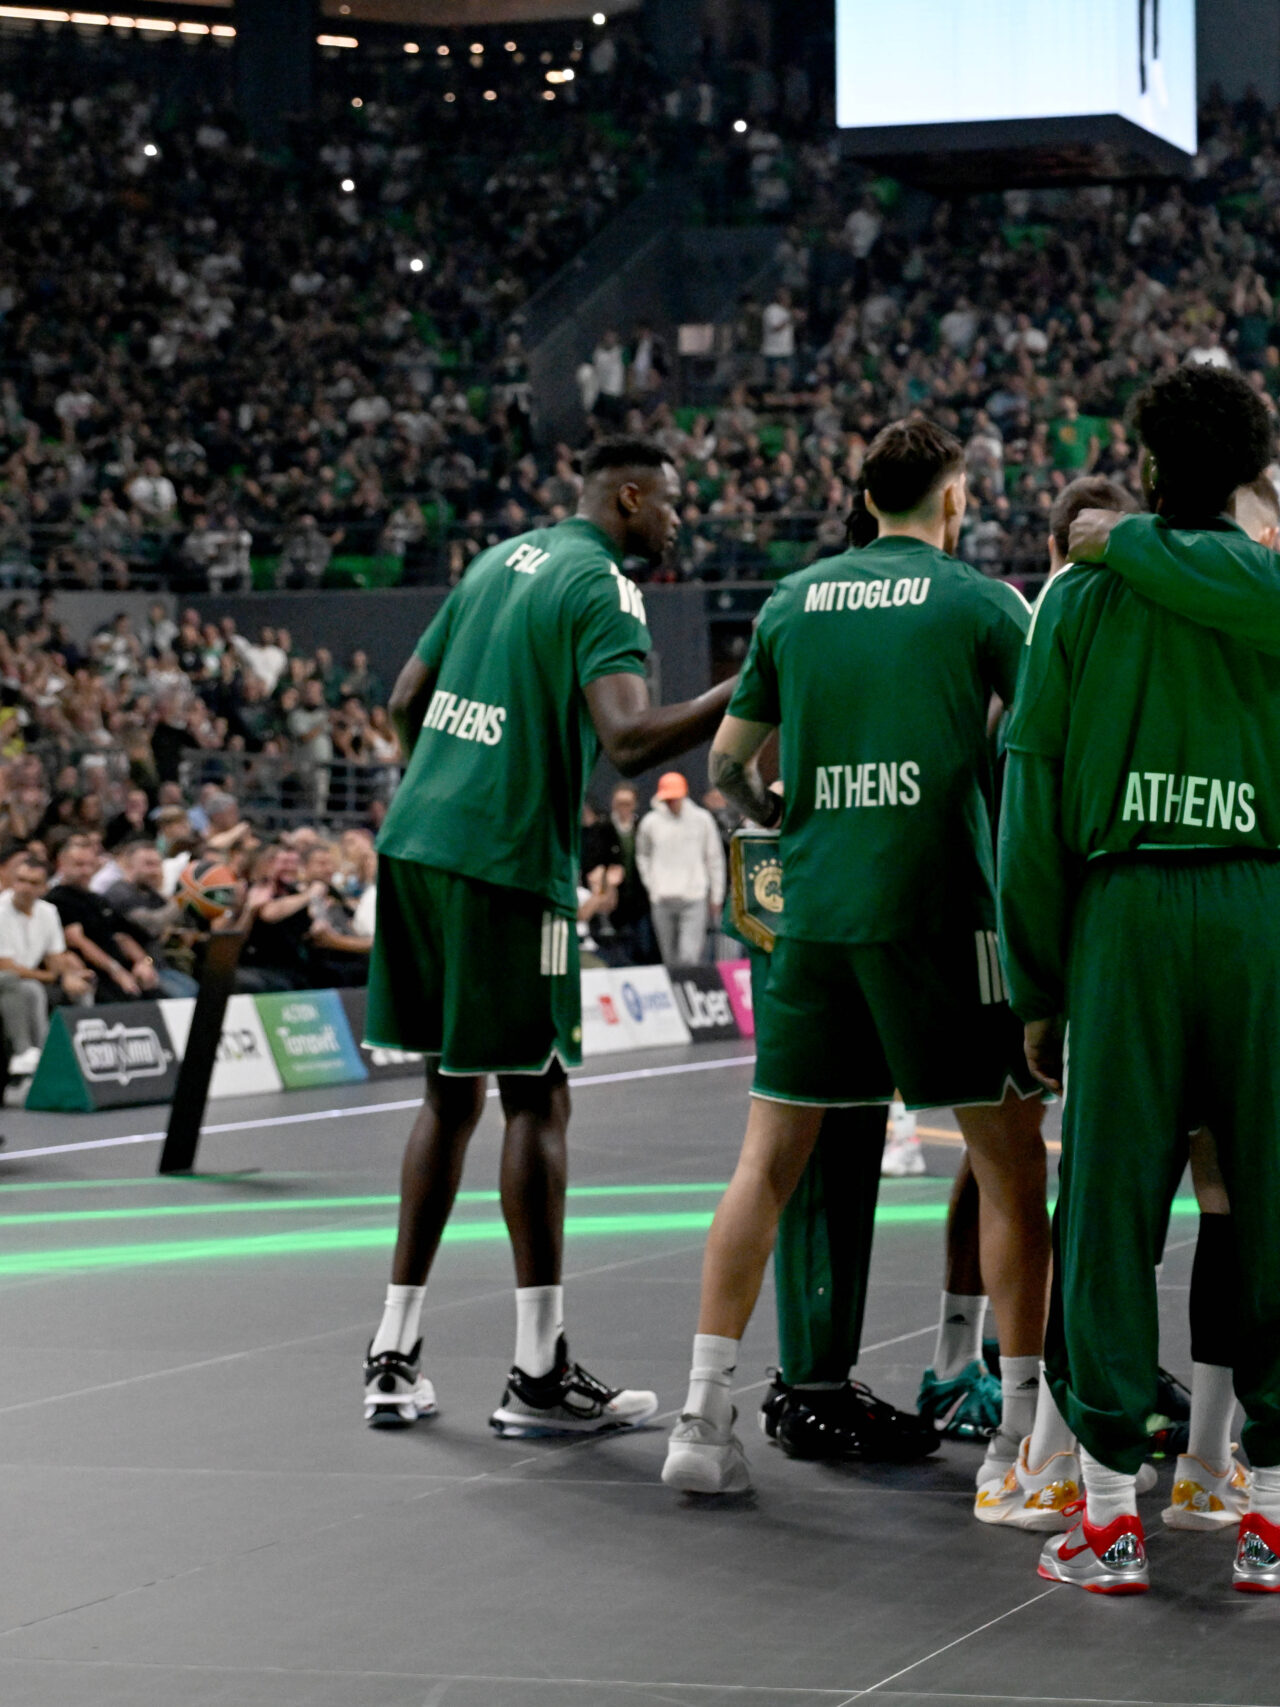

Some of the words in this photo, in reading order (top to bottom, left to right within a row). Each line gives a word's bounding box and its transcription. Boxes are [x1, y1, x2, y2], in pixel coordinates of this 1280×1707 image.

[804, 577, 931, 612] MITOGLOU
[815, 760, 921, 810] ATHENS
[1122, 771, 1256, 833] ATHENS
